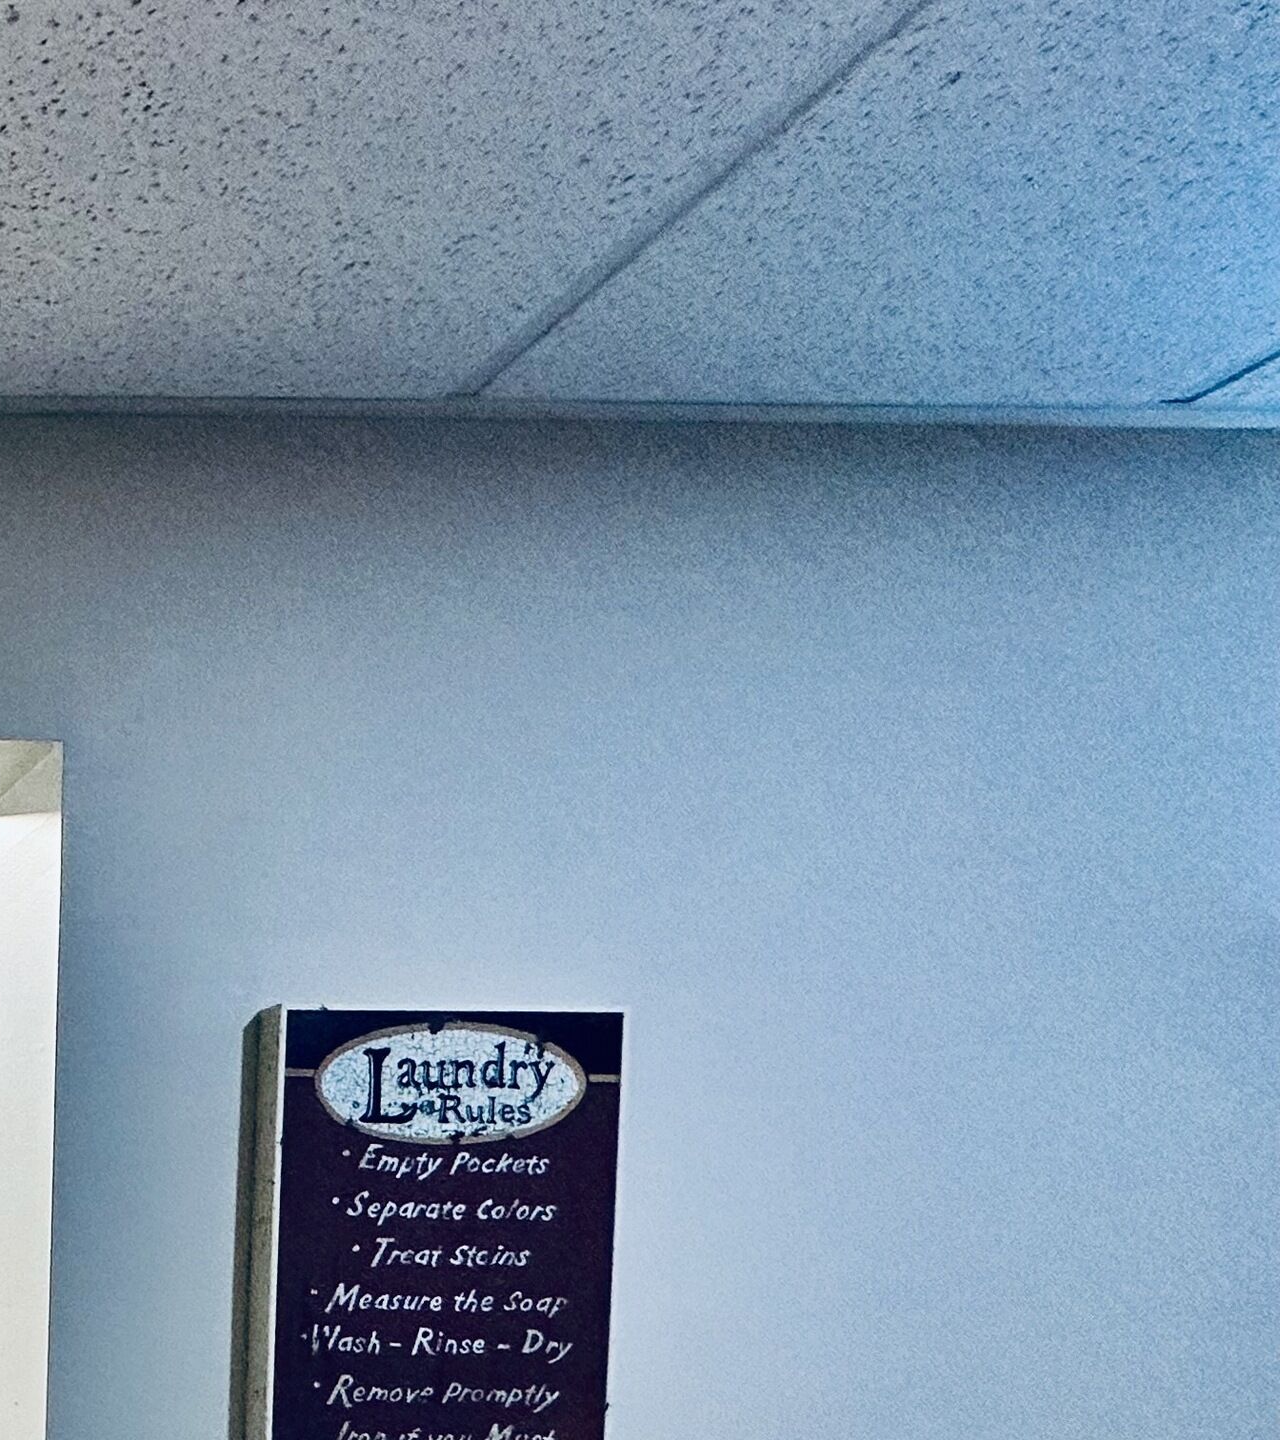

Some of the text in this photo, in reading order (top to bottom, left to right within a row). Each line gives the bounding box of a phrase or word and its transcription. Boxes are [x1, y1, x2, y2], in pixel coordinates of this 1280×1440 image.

[358, 1042, 558, 1125] Laundry
[438, 1094, 533, 1127] Rules
[358, 1143, 551, 1181] Empty Pockets
[346, 1190, 558, 1227] Separate Colors
[369, 1236, 532, 1270] Treat Stains
[324, 1281, 569, 1320] Measure the Soap
[310, 1322, 382, 1356] Wash
[411, 1326, 486, 1357] Rinse
[521, 1328, 574, 1364] Dry
[326, 1373, 561, 1414] Remove Promptly
